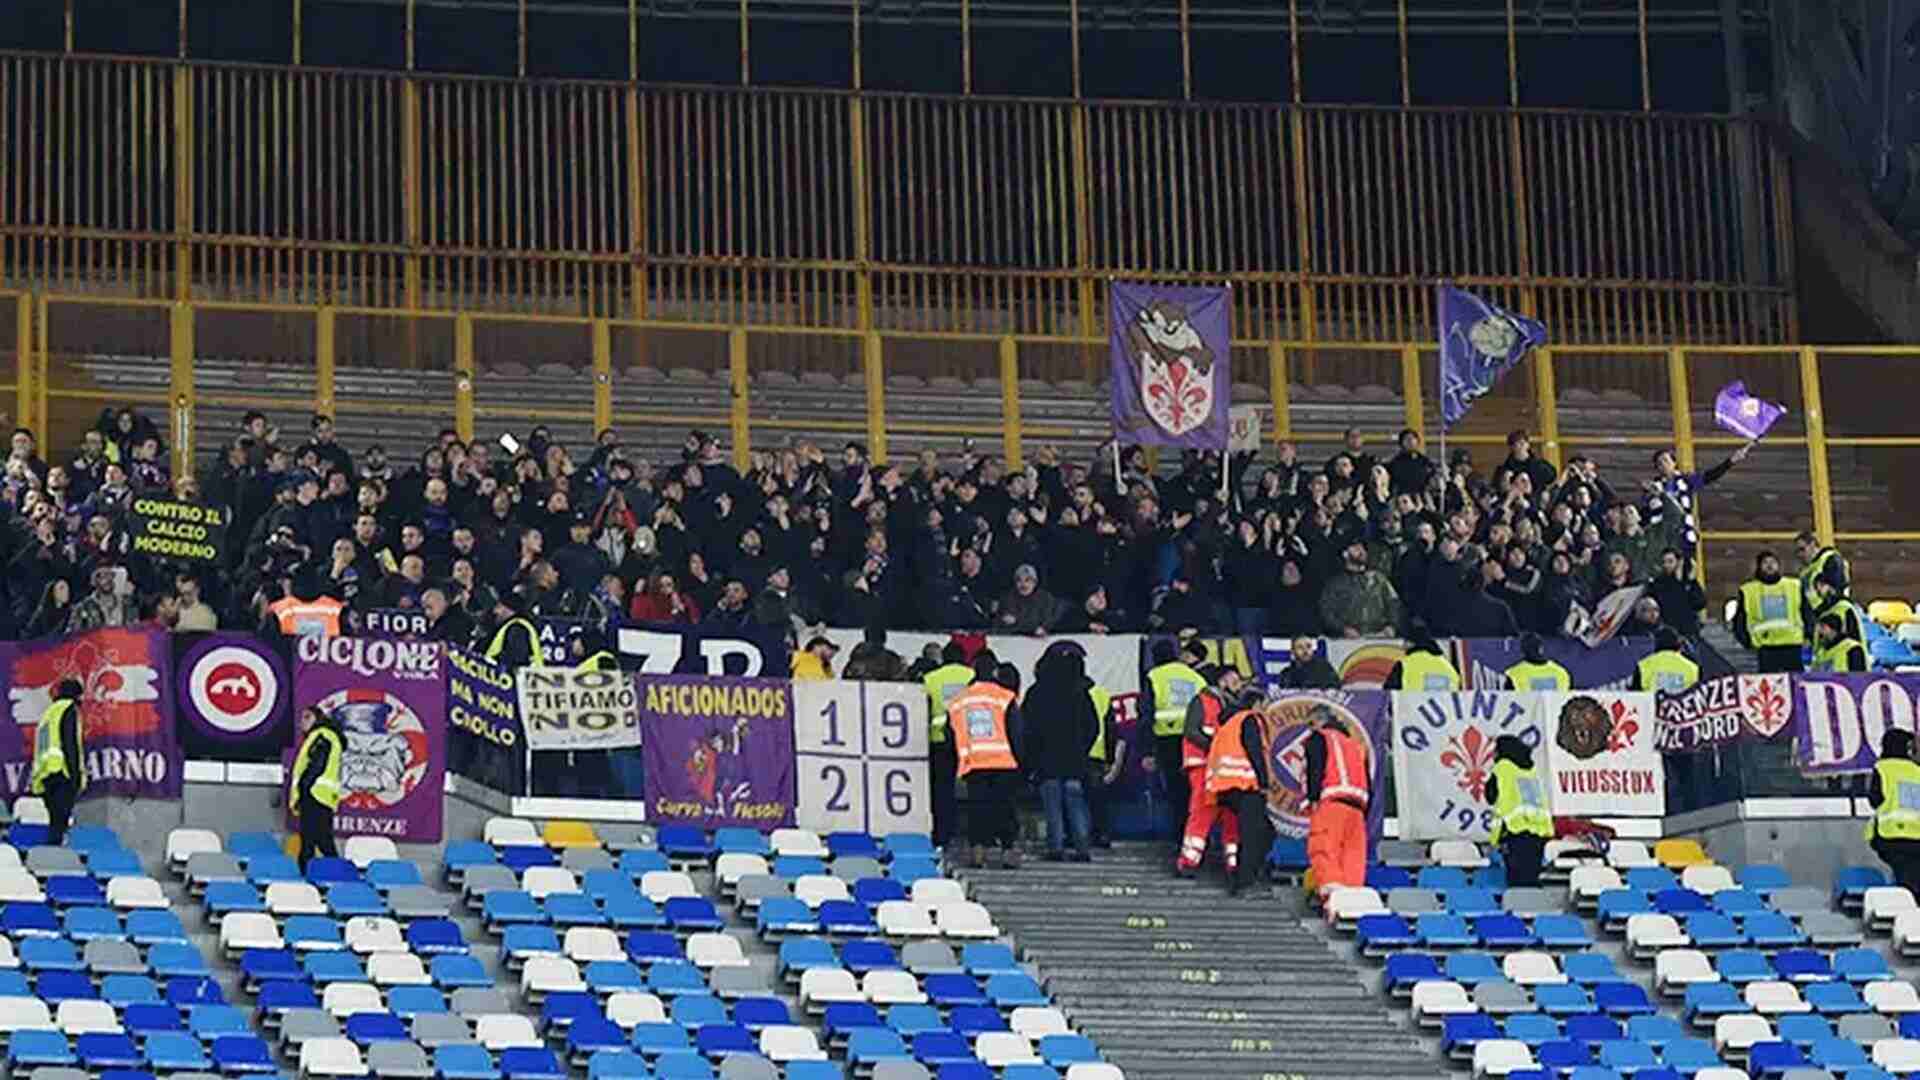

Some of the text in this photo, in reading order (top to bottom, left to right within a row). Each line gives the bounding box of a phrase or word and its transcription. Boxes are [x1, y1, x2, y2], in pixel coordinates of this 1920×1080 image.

[147, 520, 206, 541] CALCIO
[134, 536, 216, 559] MODERNO
[298, 634, 440, 677] CICLONE
[478, 692, 514, 720] NON
[526, 689, 633, 709] TIFIAMO
[646, 685, 786, 719] AFICIONADOS
[1400, 689, 1542, 752] QUINTO
[1558, 769, 1656, 795] VIEUSSEUX
[332, 815, 408, 836] IRENZE
